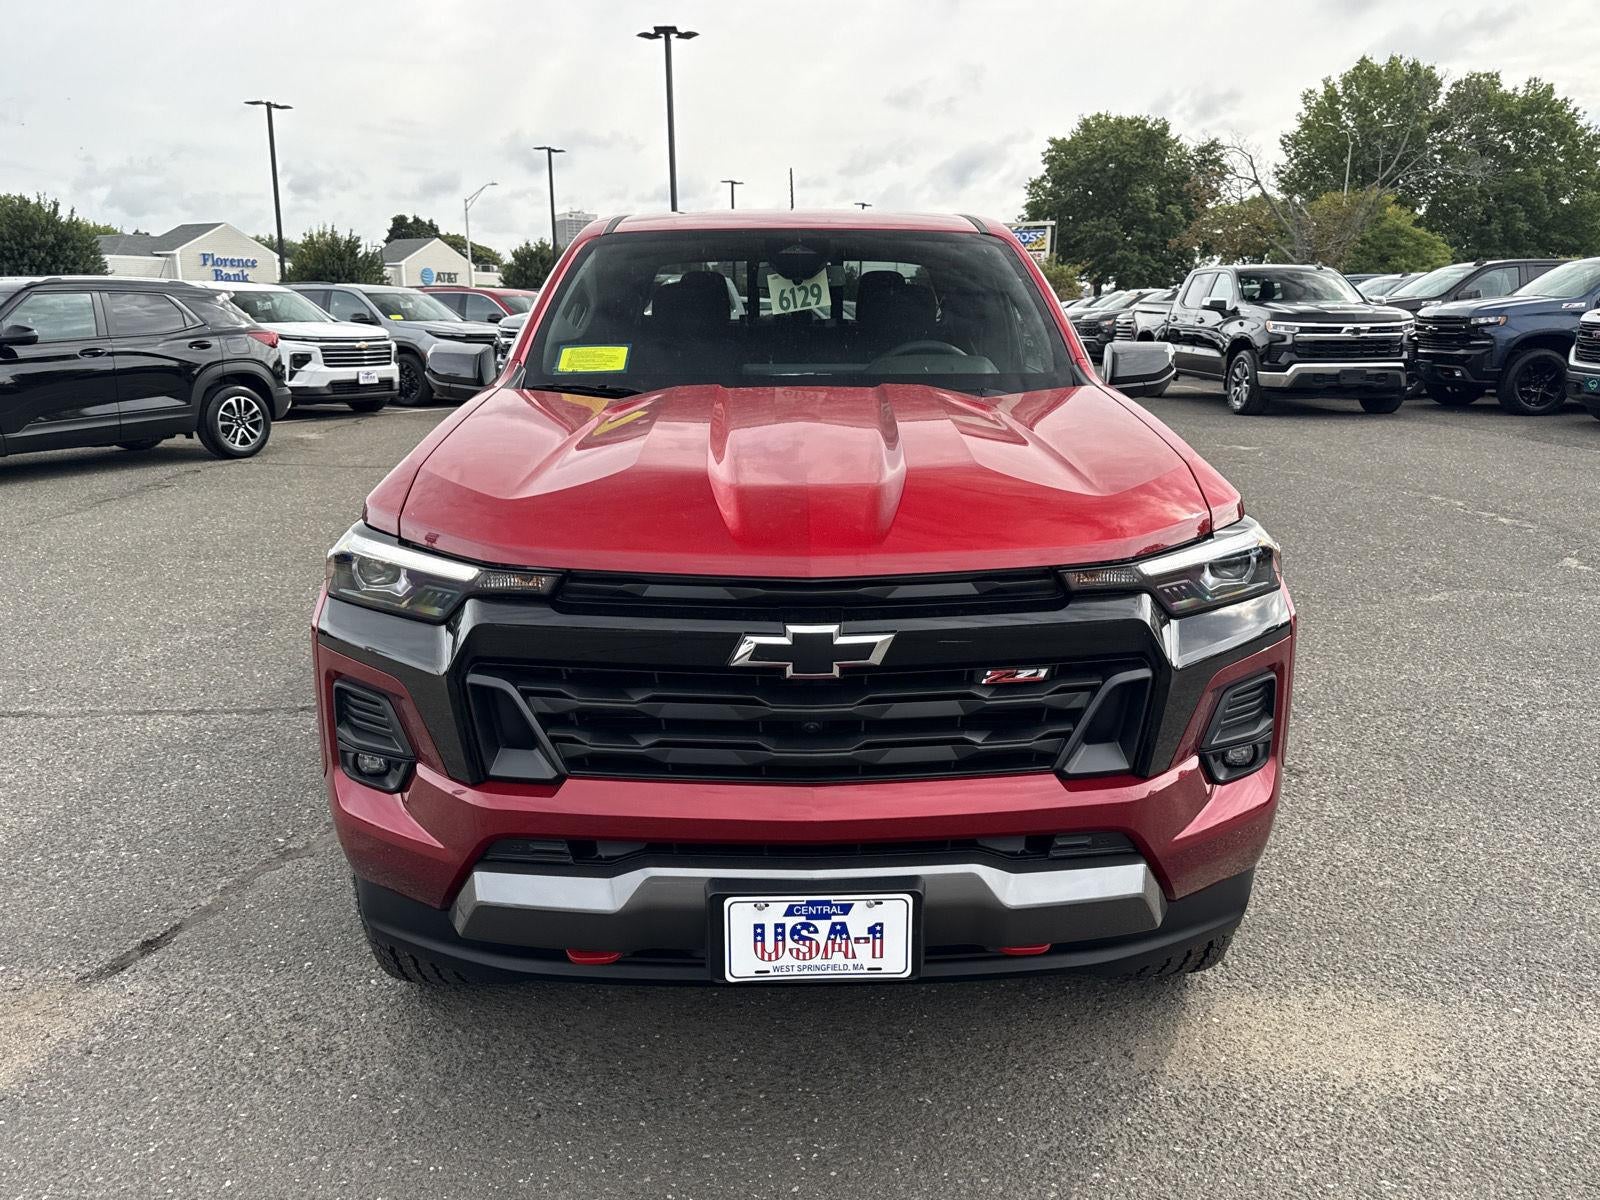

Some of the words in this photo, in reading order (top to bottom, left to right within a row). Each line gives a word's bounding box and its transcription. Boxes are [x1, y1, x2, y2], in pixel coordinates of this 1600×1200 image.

[200, 252, 258, 268] Florence
[211, 268, 250, 282] Bank
[435, 271, 459, 284] AT&T
[778, 283, 823, 311] 6129
[793, 905, 844, 916] CENTRAL
[753, 921, 885, 962] USA-1
[772, 965, 795, 973] WEST
[796, 963, 850, 973] SPRINGFIELD,
[852, 963, 865, 972] MA
